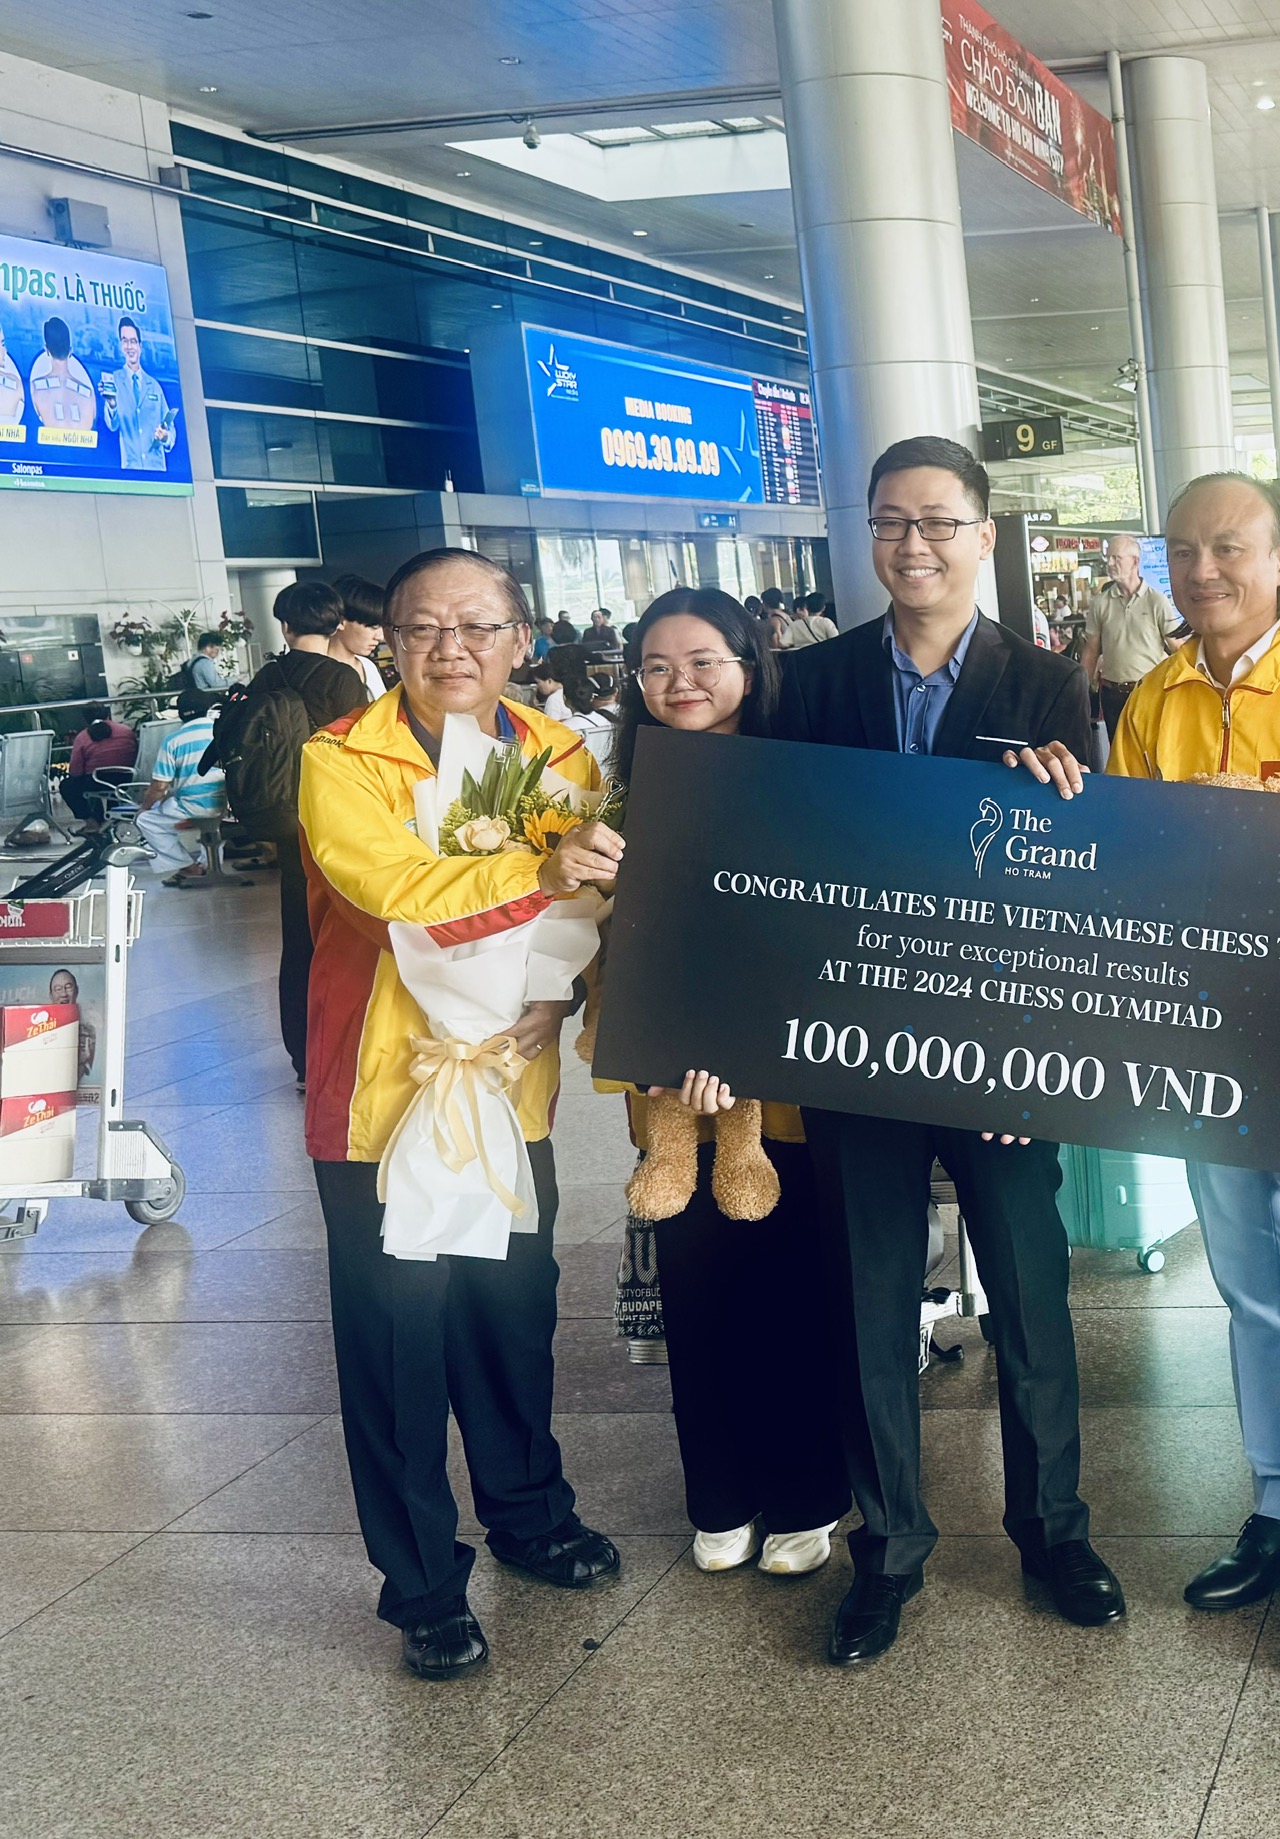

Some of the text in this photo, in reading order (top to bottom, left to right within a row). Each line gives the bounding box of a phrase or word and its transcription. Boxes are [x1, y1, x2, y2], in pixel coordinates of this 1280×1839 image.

[961, 39, 1003, 96] CHÀO
[1006, 75, 1036, 125] ĐÓN
[64, 273, 87, 303] LÀ
[89, 281, 146, 313] THUỐC
[601, 427, 720, 476] 0969.39.89.89
[1016, 424, 1058, 452] 9 GF
[1009, 808, 1052, 833] The
[1004, 867, 1051, 880] HO TRAM
[1005, 835, 1097, 871] Grand
[713, 871, 936, 917] CONGRATULATES
[944, 897, 995, 925] THE
[1002, 904, 1174, 946] VIETNAMESE
[1181, 926, 1269, 957] CHESS
[856, 924, 1190, 988] for your exceptional results
[818, 959, 1222, 1030] AT THE 2024 CHESS OLYMPIAD
[780, 1018, 1244, 1119] 100,000,000 VND
